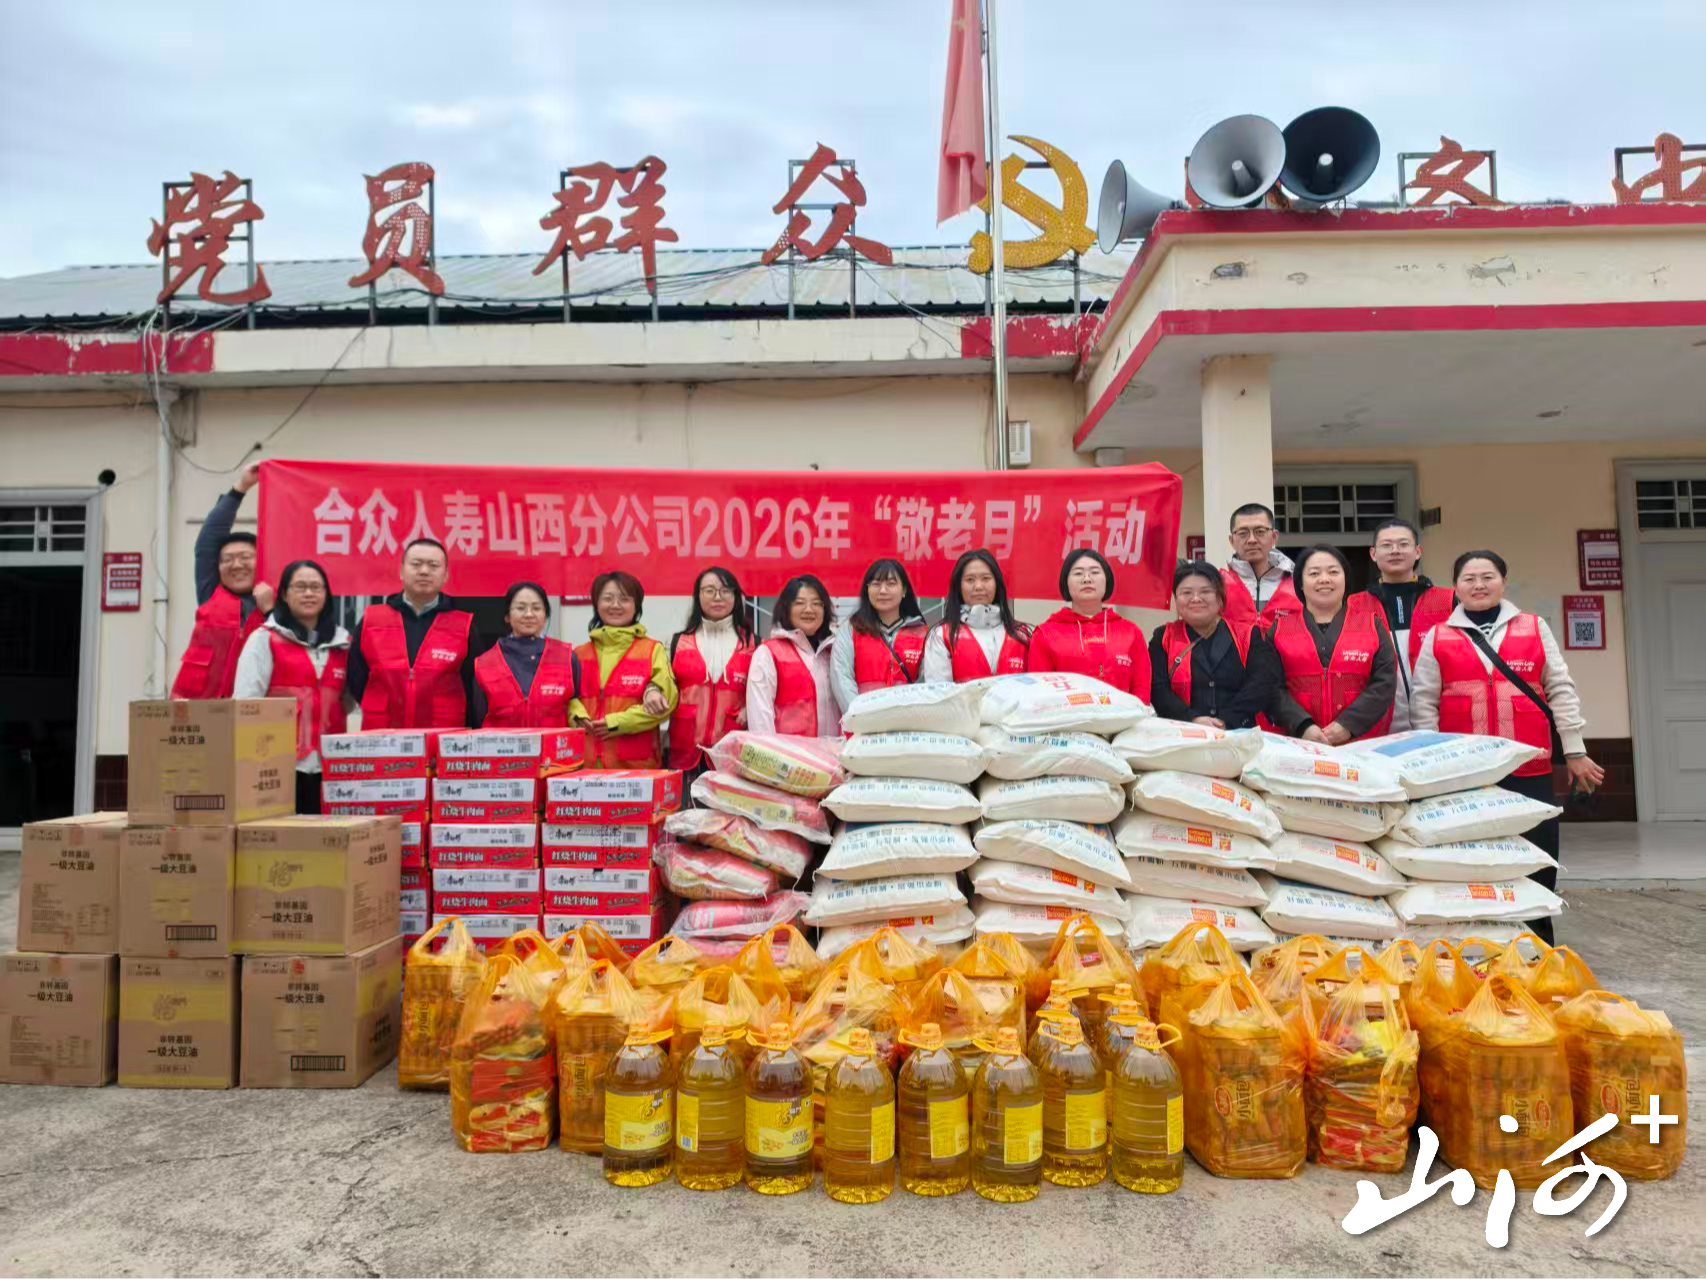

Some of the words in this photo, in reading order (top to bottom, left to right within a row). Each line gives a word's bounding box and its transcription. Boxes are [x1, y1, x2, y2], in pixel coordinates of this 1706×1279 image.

[159, 735, 206, 746] 一级大豆油
[329, 763, 375, 773] 红烧牛肉面
[446, 761, 491, 772] 红烧牛肉面
[440, 806, 486, 817] 红烧牛肉面
[555, 806, 602, 817] 红烧牛肉面
[438, 852, 484, 863] 红烧牛肉面
[551, 851, 598, 862] 红烧牛肉面
[50, 860, 95, 872] 一级大豆油
[151, 863, 197, 874] 一级大豆油
[441, 897, 488, 907] 红烧牛肉面
[552, 896, 599, 907] 红烧牛肉面
[261, 912, 313, 924] 一级大豆油
[27, 991, 73, 1003] 一级大豆油
[273, 992, 325, 1005] 一级大豆油
[147, 1046, 199, 1058] 一级大豆油
[1236, 1080, 1251, 1120] 小面包
[1625, 1078, 1641, 1116] 小面包
